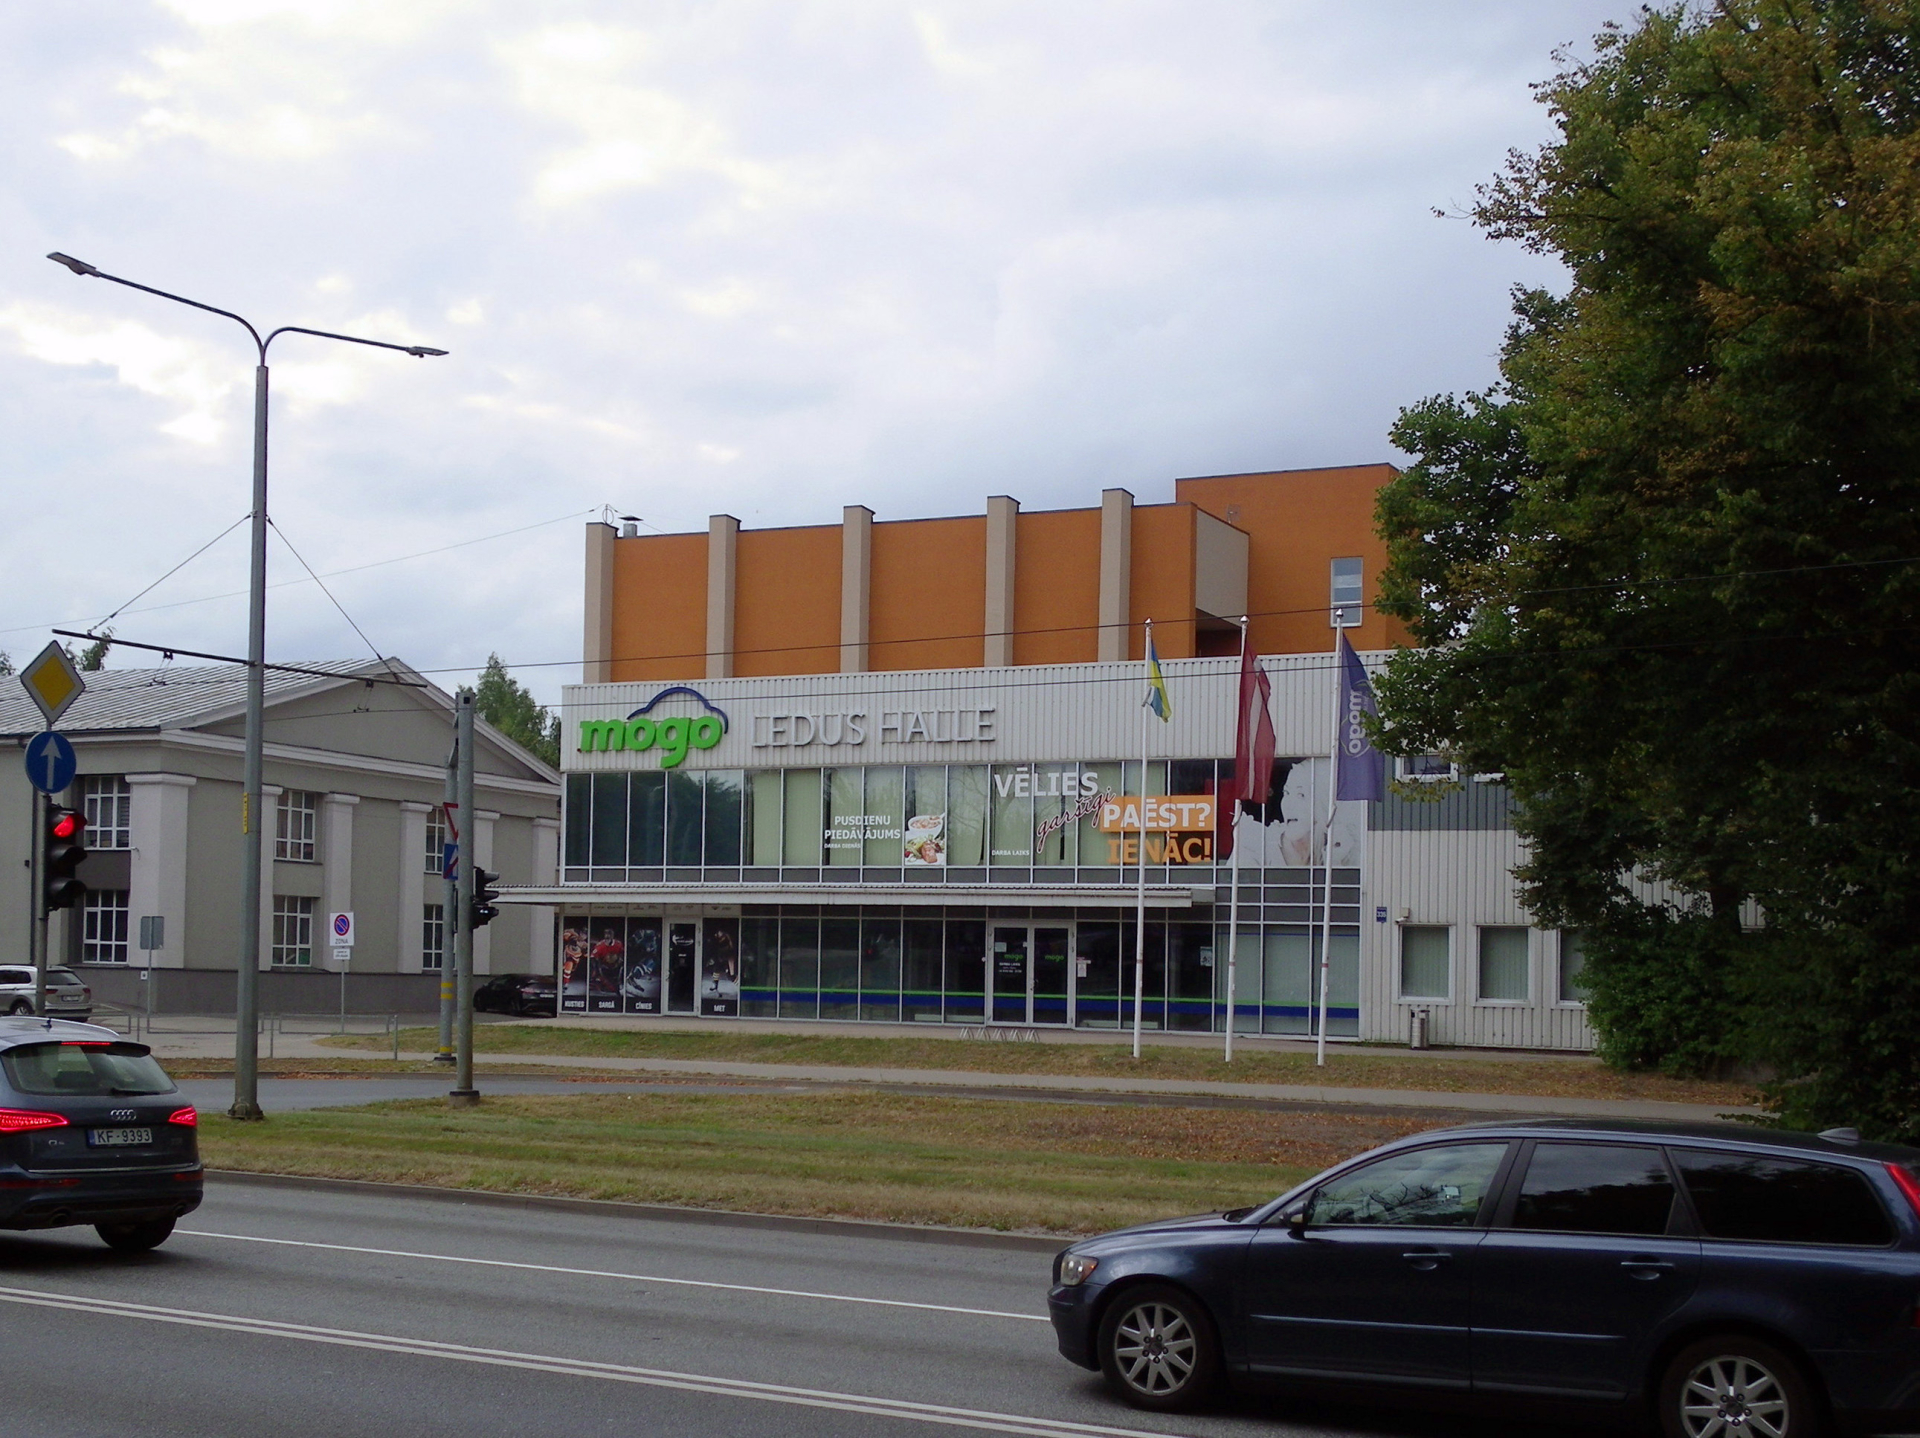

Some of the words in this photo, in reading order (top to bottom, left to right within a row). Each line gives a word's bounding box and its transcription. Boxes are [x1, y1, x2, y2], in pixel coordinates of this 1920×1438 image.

[752, 712, 867, 747] LEDUS
[880, 707, 997, 745] HALLE
[1349, 690, 1367, 754] mogo
[580, 716, 723, 769] mogo
[994, 767, 1099, 798] VĒLIES
[834, 815, 890, 825] PUSDIENU
[1037, 786, 1116, 854] garšīgi
[1103, 798, 1211, 828] PAĒST?
[824, 827, 900, 839] PIEDĀVĀJUMS
[1107, 832, 1212, 864] IENĀC!
[991, 849, 1011, 857] DARBA
[1044, 954, 1064, 962] mogo
[97, 1129, 151, 1143] KF-9393
